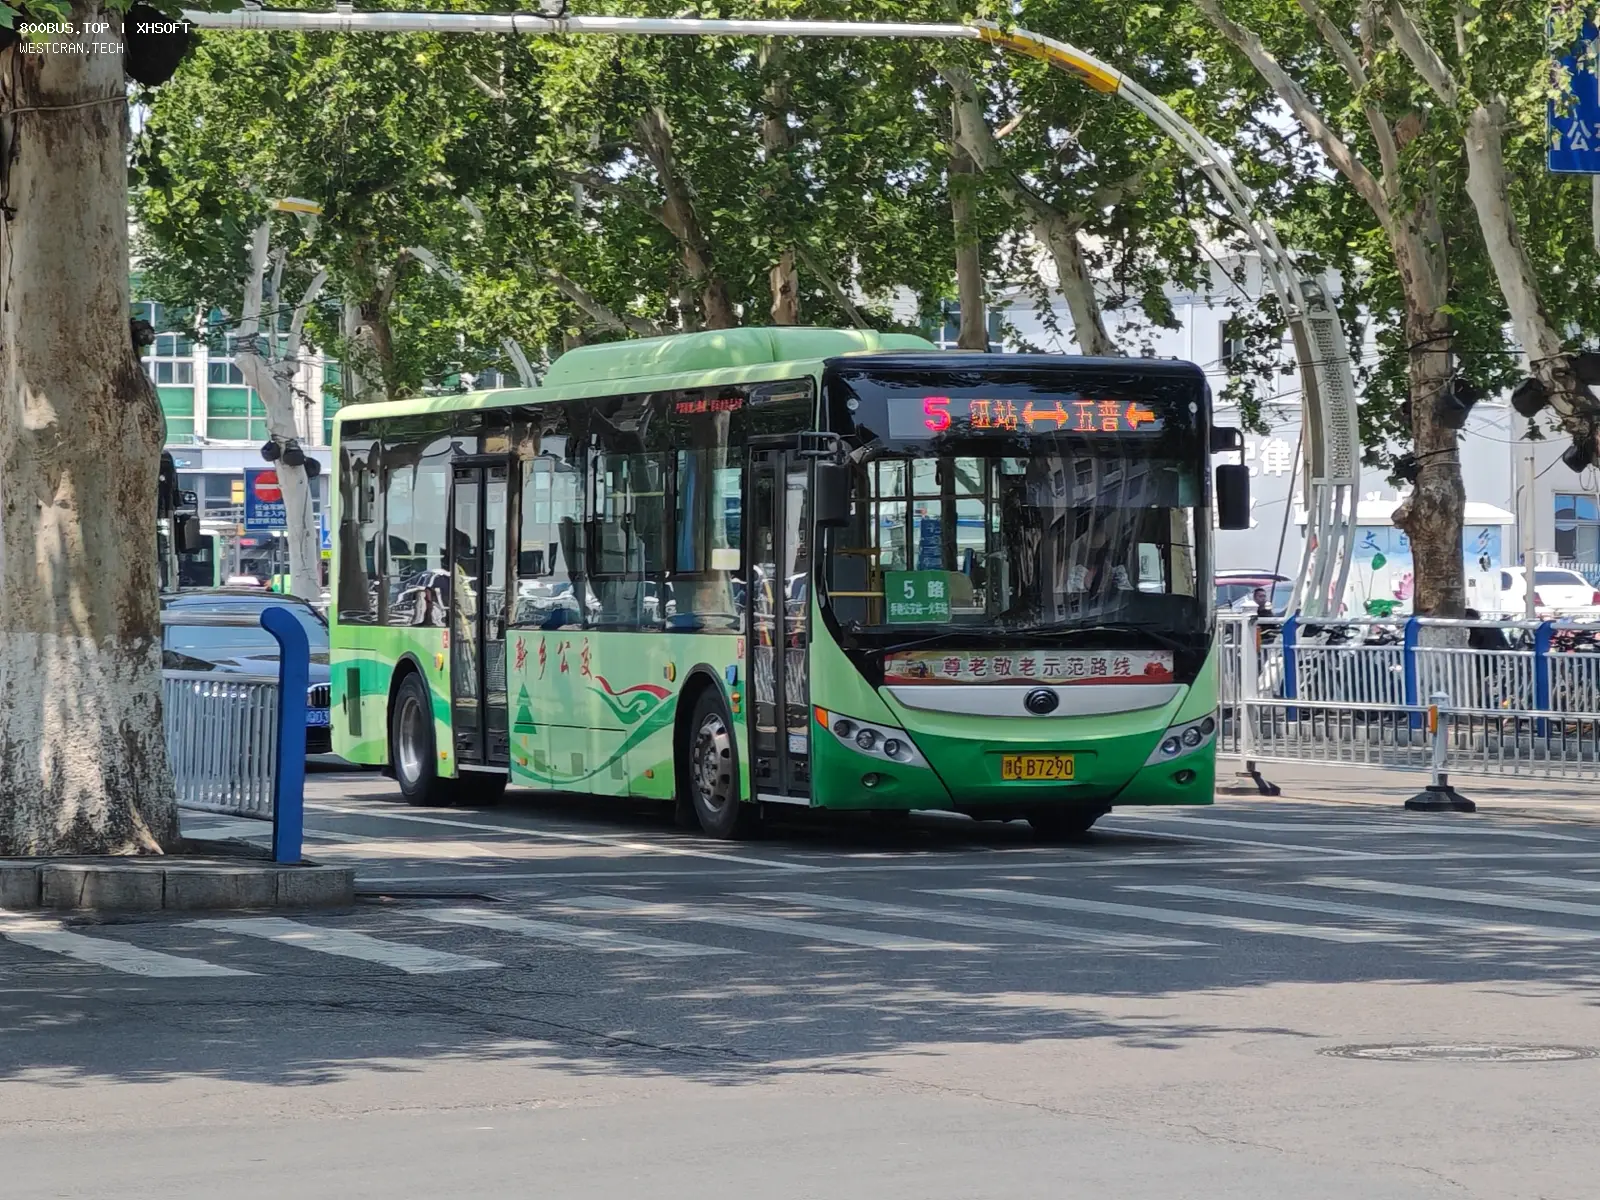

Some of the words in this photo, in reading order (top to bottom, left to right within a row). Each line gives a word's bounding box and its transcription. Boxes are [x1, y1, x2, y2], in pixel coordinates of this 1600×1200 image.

[923, 397, 950, 431] 5
[904, 580, 915, 599] 5
[927, 580, 945, 598] 路
[943, 656, 1132, 677] 尊老敬老示范路线
